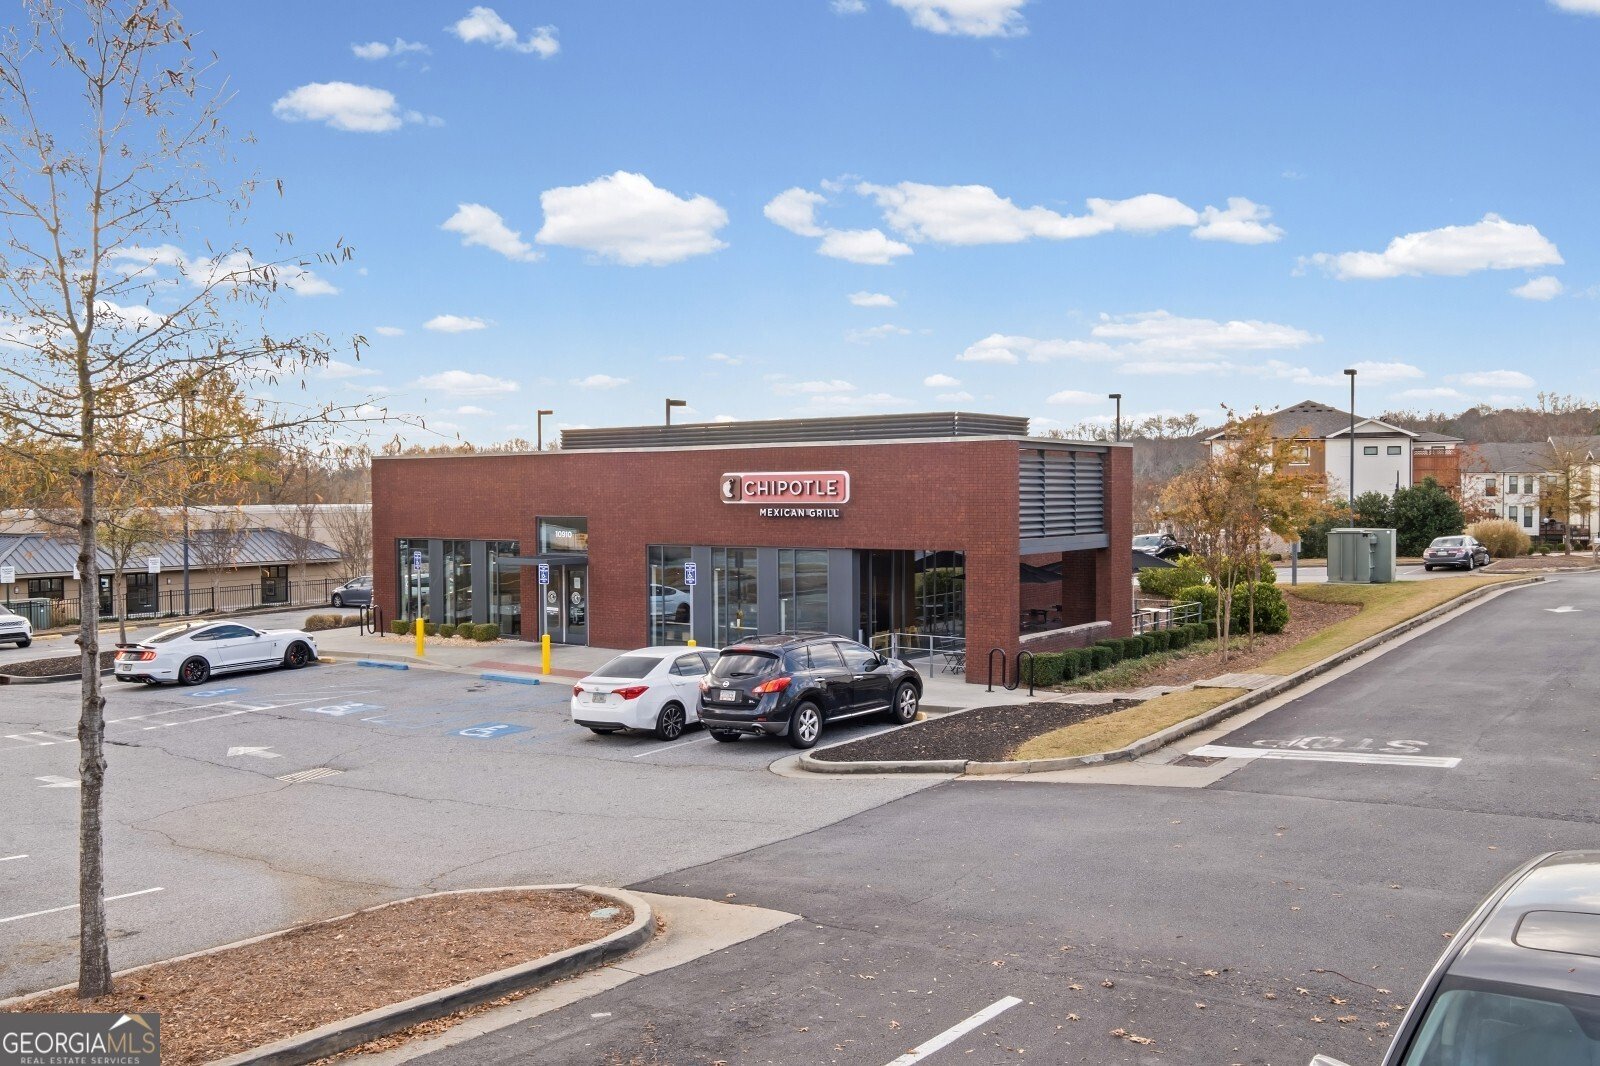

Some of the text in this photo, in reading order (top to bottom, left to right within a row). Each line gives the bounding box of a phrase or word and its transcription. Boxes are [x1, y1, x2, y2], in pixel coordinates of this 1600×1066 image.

[744, 479, 838, 496] CHIPOTLE
[759, 508, 840, 518] MEXICAN GRILL
[555, 530, 573, 538] 10910
[1251, 736, 1429, 753] STOP
